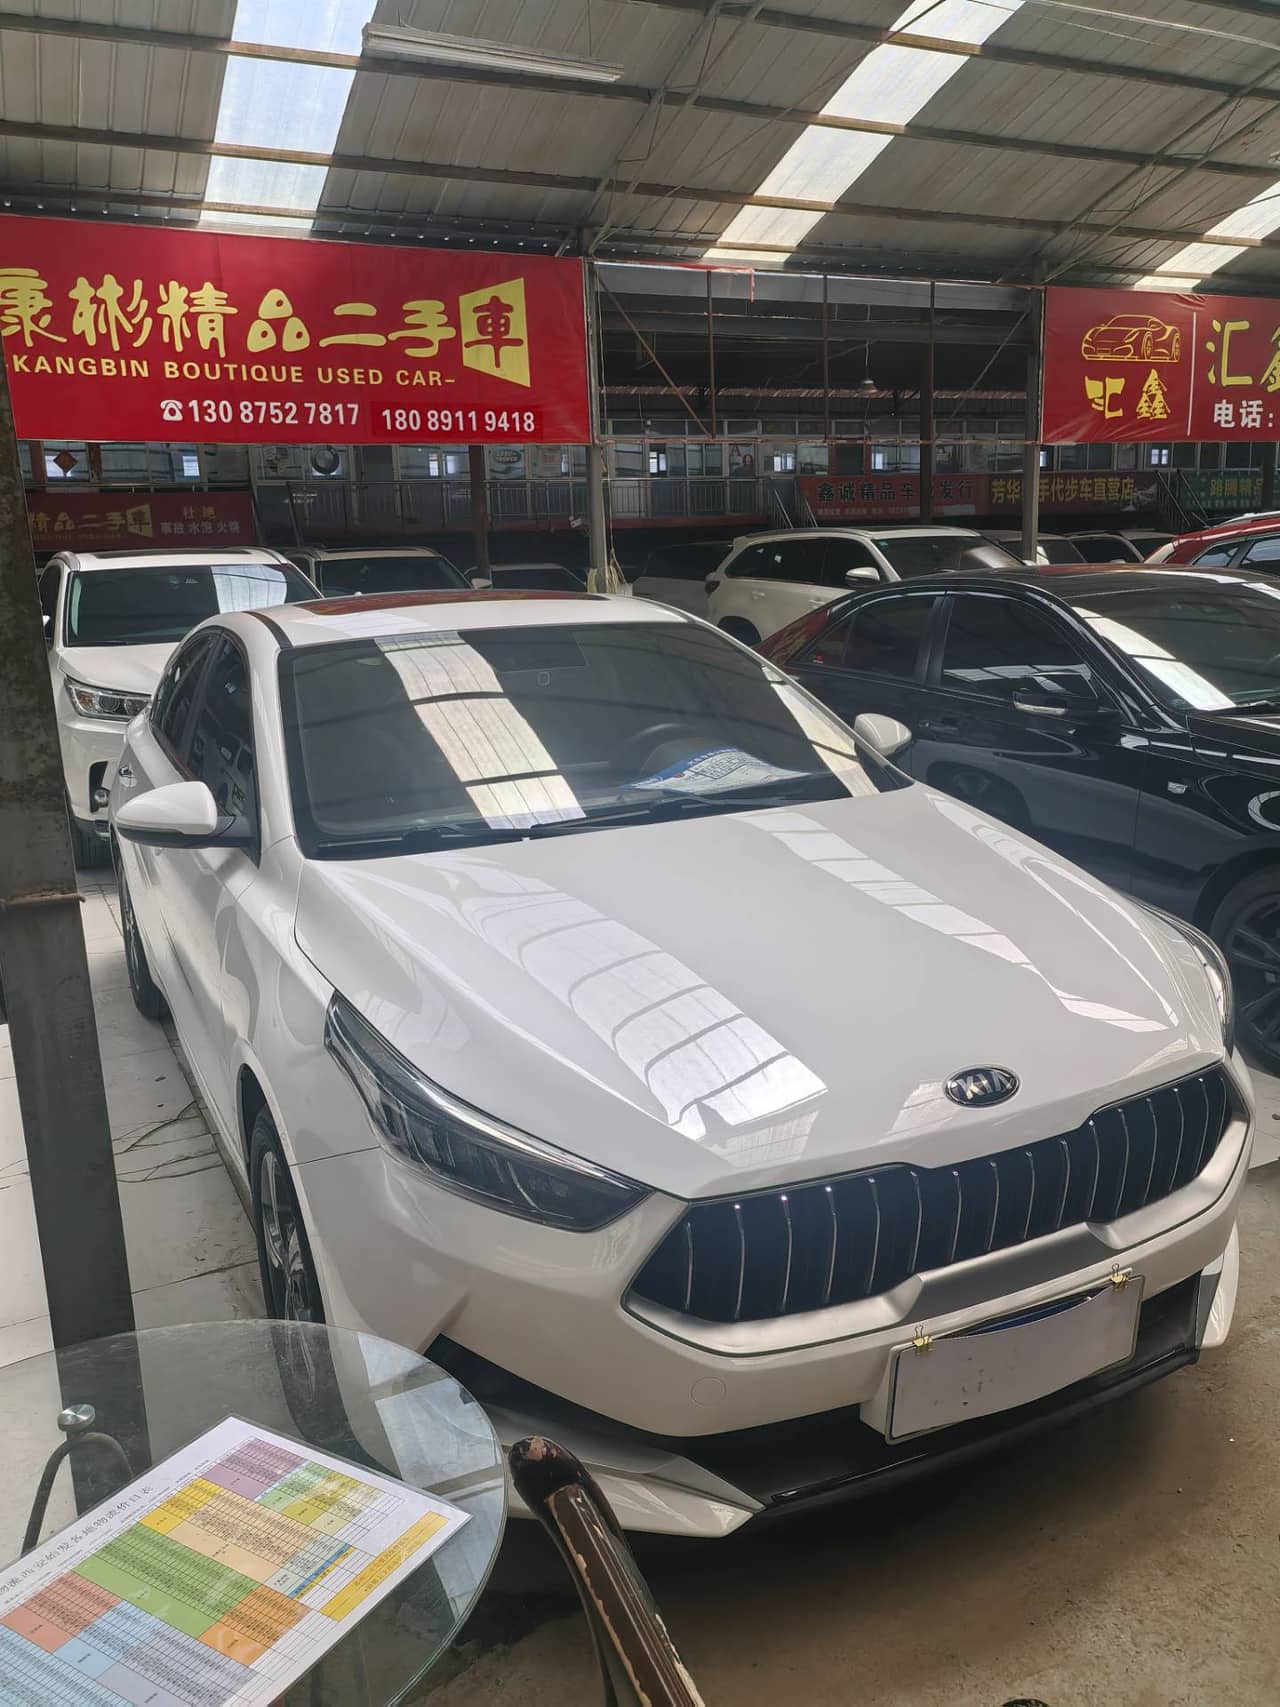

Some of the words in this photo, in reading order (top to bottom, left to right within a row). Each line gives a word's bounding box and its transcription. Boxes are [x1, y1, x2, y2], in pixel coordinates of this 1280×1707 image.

[12, 354, 149, 378] KANGBIN
[164, 361, 304, 383] BOUTIQUE
[318, 367, 383, 385] USED
[1084, 368, 1171, 419] 汇鑫
[188, 399, 233, 423] 130
[240, 401, 299, 425] 8752
[303, 402, 359, 425] 7817
[382, 408, 421, 431] 180
[427, 409, 477, 432] 8911
[484, 411, 535, 433] 9418
[817, 481, 976, 502] 鑫诚精品车发行
[991, 477, 1136, 503] 芳华手代步车直营店
[956, 1070, 1011, 1100] KIA
